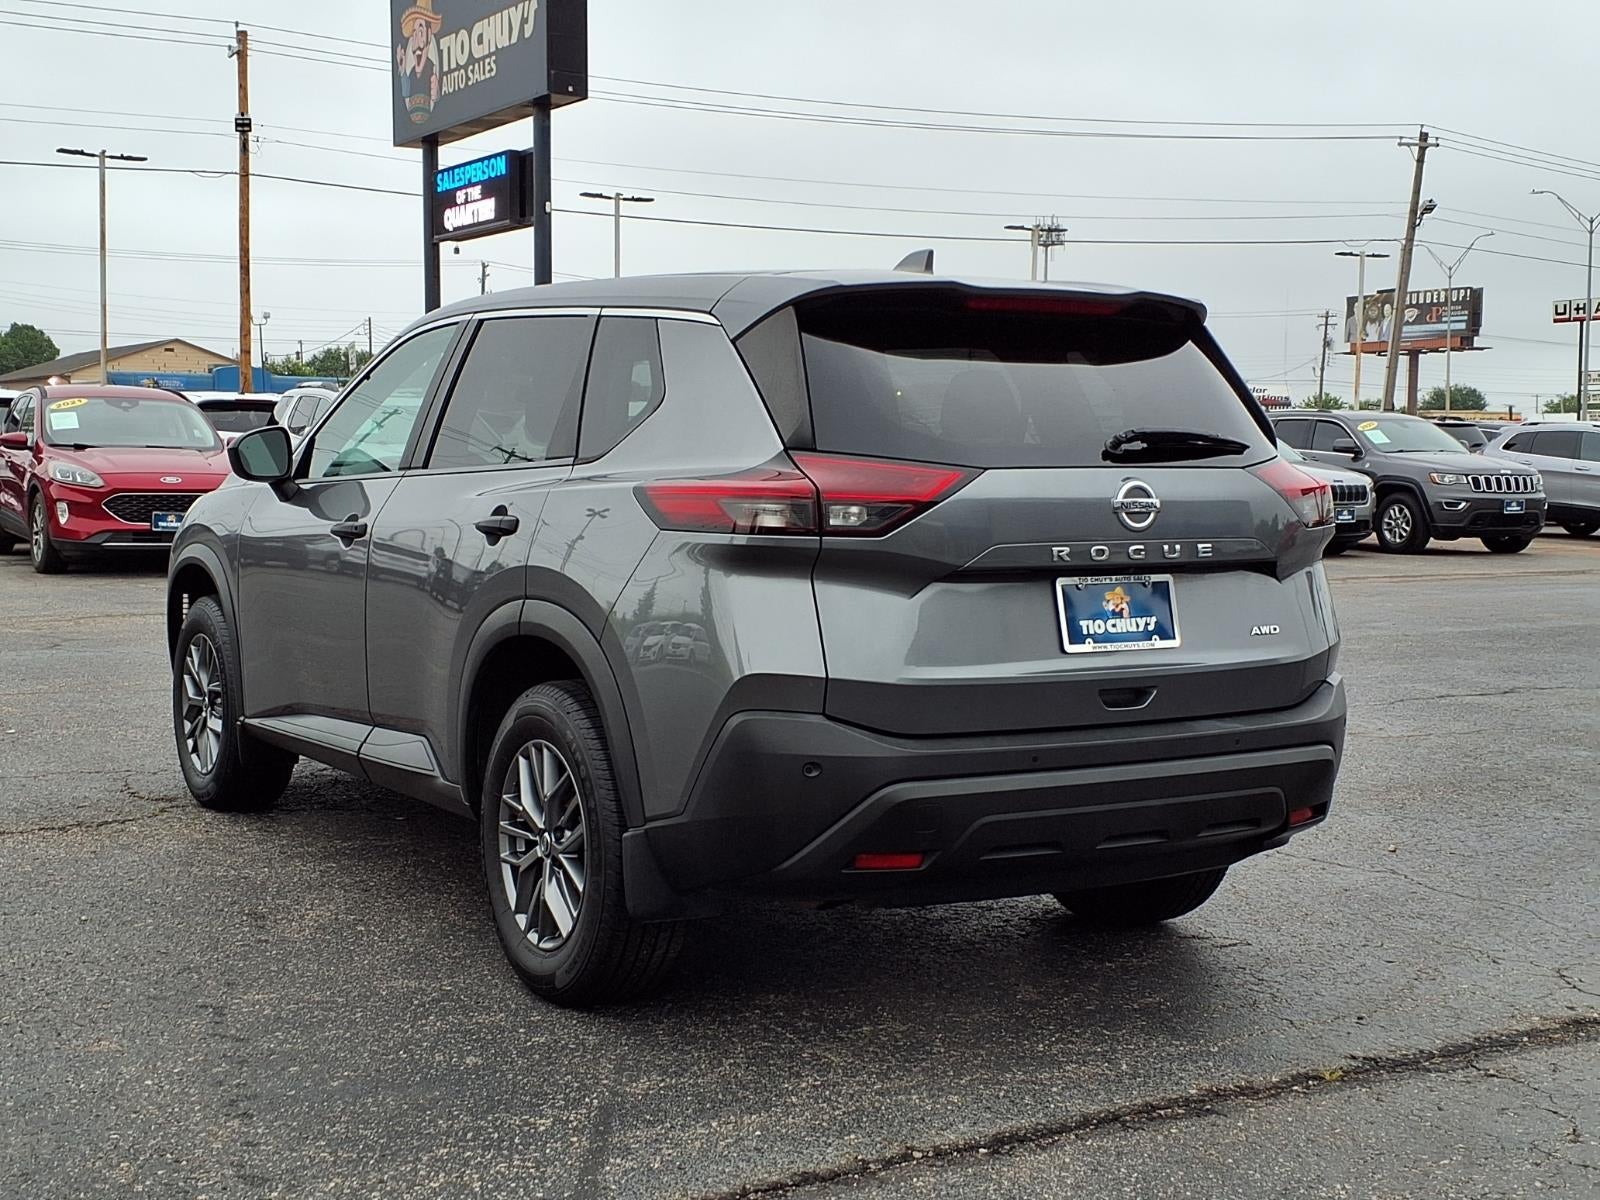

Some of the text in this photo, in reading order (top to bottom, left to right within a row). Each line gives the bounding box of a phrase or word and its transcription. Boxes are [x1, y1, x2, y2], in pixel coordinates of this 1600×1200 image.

[440, 0, 538, 73] TIO CHUY'S
[441, 55, 497, 96] AUTO SALES
[437, 155, 506, 193] SALESPERSON
[456, 185, 482, 205] OF THE
[1405, 288, 1470, 305] HUNDER UP!
[1120, 501, 1157, 509] NISSAN
[1051, 543, 1213, 561] ROGUE
[1079, 615, 1157, 635] TIO CHUY'S
[1250, 625, 1280, 636] AWD
[1092, 643, 1156, 651] WWW.TIOCHUYS.COM
